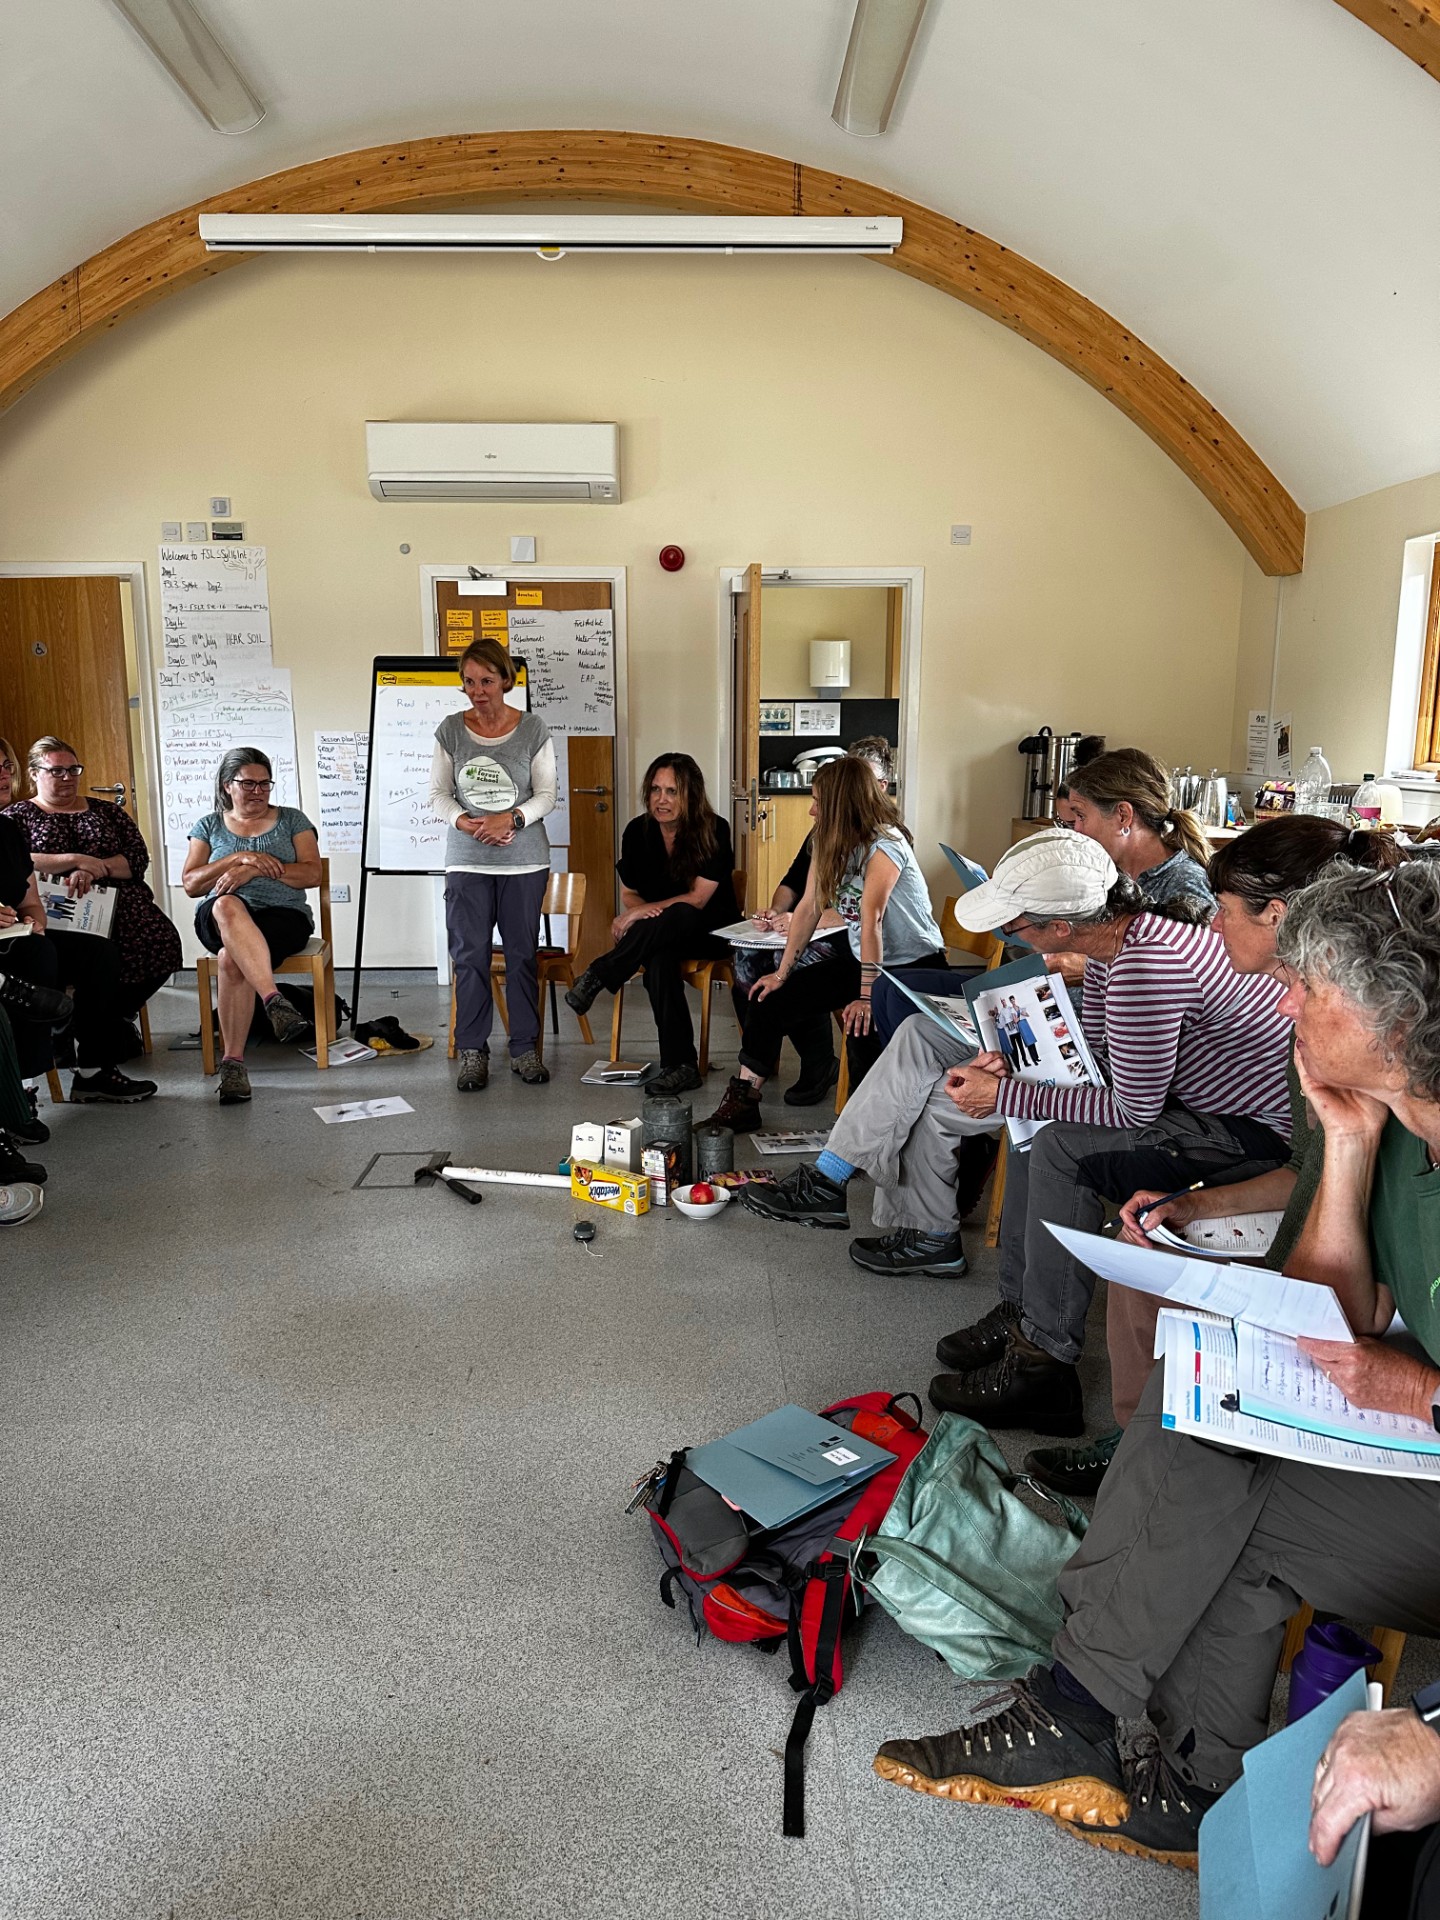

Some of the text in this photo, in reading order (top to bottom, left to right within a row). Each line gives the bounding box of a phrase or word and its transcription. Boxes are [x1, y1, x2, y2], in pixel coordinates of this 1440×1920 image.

[161, 547, 190, 561] Welcome
[190, 550, 198, 560] to
[164, 616, 178, 631] Day
[165, 633, 178, 648] Day
[178, 634, 185, 645] 5
[203, 633, 218, 650] July
[247, 633, 267, 645] SOIL
[577, 648, 596, 656] Medical
[168, 656, 180, 668] Day
[180, 655, 186, 665] 6
[202, 652, 218, 669] July
[159, 672, 172, 687] Day
[200, 670, 215, 686] July
[162, 694, 179, 710] DAY
[203, 687, 219, 700] July
[396, 698, 415, 708] Read
[584, 702, 598, 713] PPE
[172, 712, 189, 728] Day
[226, 711, 244, 725] July
[172, 729, 185, 738] DAY
[215, 728, 232, 742] July
[321, 735, 340, 743] Session
[341, 736, 354, 744] plan
[199, 740, 209, 748] and
[194, 770, 208, 781] and
[476, 776, 499, 784] school
[478, 770, 499, 778] forest
[177, 793, 195, 808] Rope
[422, 816, 448, 825] Evidenc
[420, 835, 440, 843] Control
[80, 899, 93, 930] Food Safety
[590, 1185, 620, 1198] Weetabix
